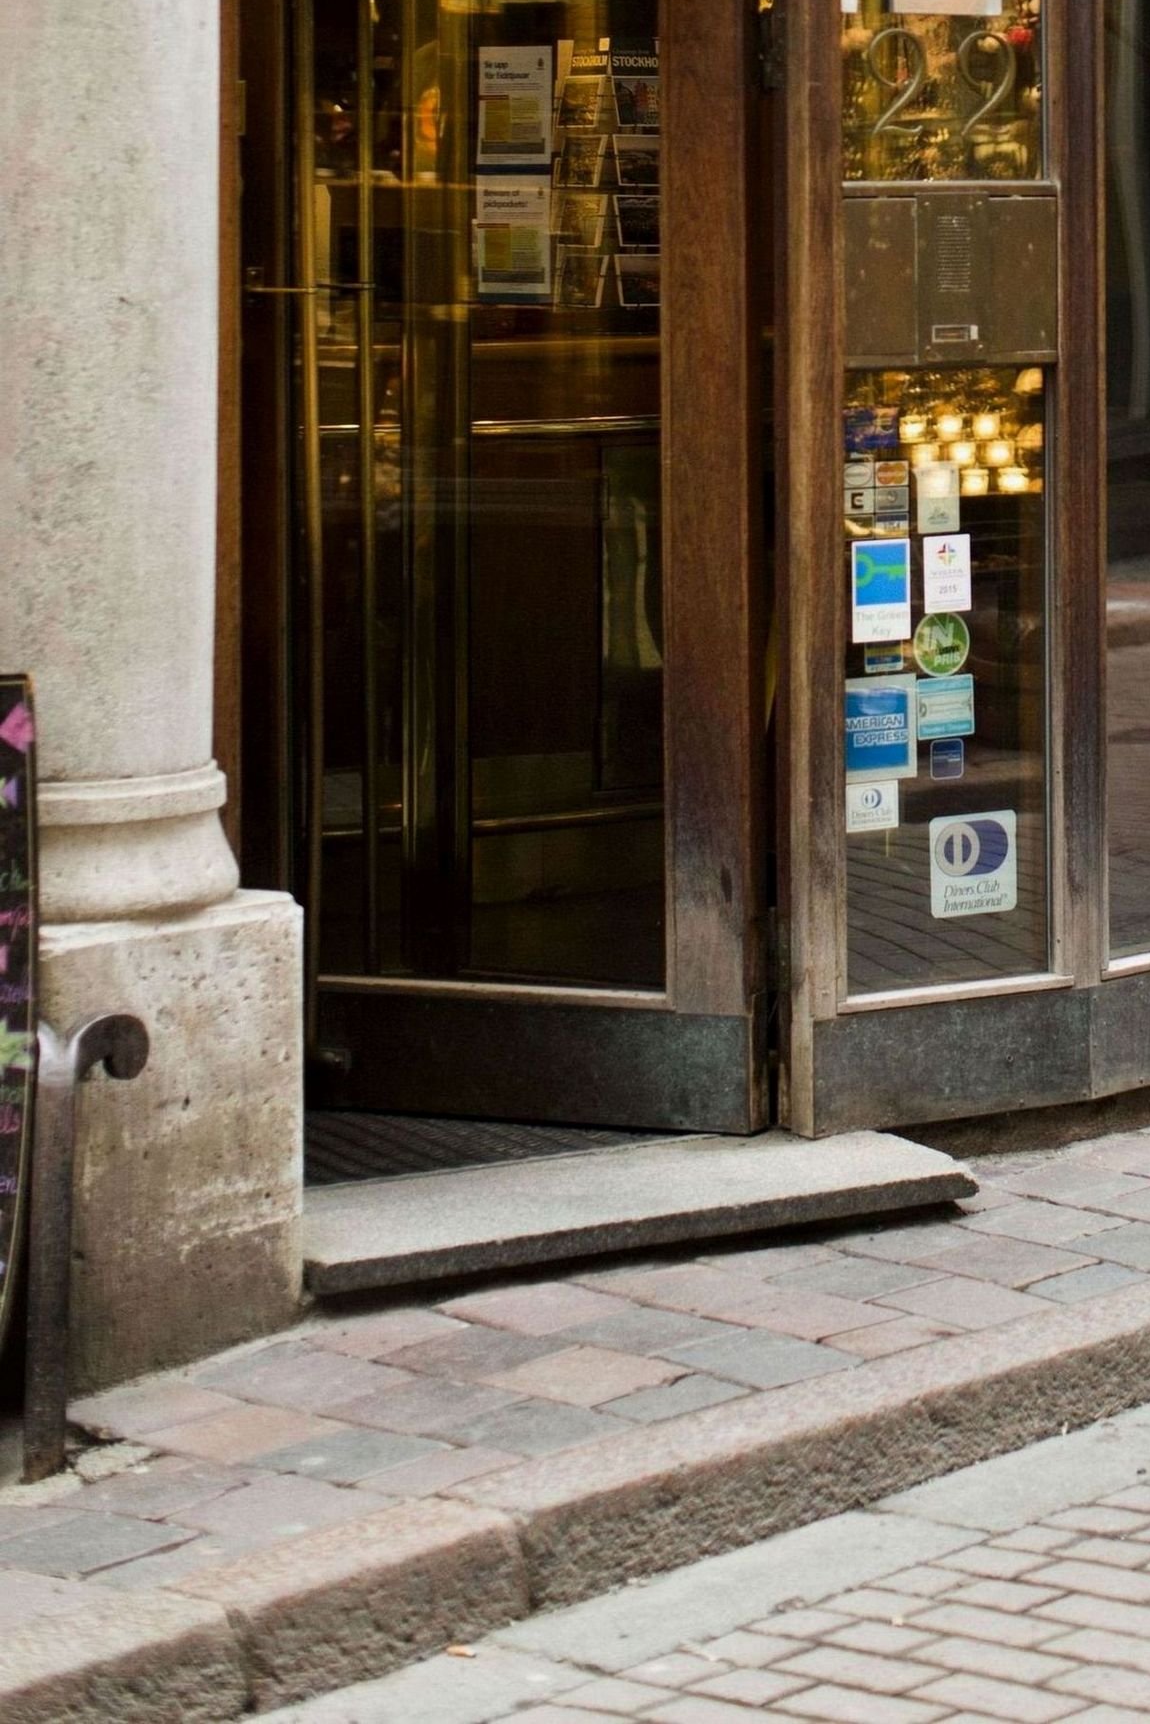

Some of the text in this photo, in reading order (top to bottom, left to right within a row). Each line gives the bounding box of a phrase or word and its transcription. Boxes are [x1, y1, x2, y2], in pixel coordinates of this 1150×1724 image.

[855, 731, 908, 745] EXPRESS
[944, 880, 1000, 899] Diners Club
